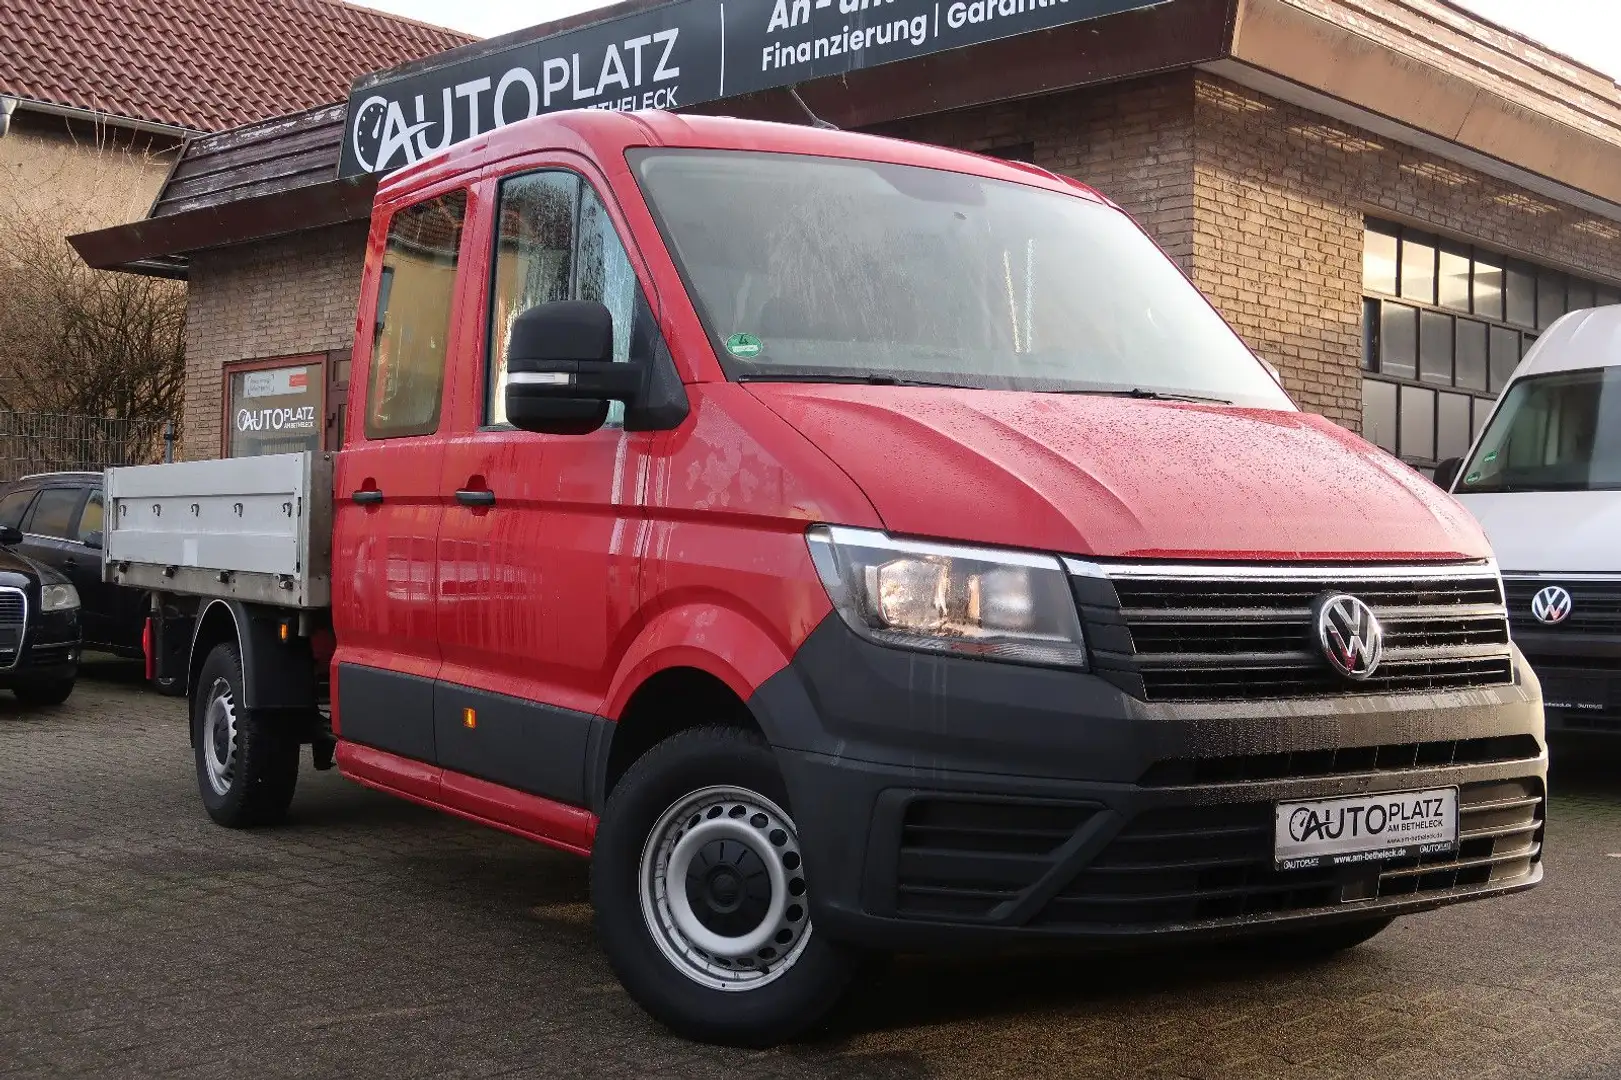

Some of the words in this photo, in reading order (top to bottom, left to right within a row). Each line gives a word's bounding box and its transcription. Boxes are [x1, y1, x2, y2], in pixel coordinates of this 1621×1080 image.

[762, 14, 927, 71] Finanzierung
[947, 0, 1070, 29] Garan
[237, 406, 315, 431] AUTOPLATZ
[1289, 797, 1444, 842] AUTOPLATZ
[1387, 824, 1400, 833] AM
[1401, 818, 1444, 831] BETHELECK
[1333, 847, 1406, 865] www.am-betheleck.de
